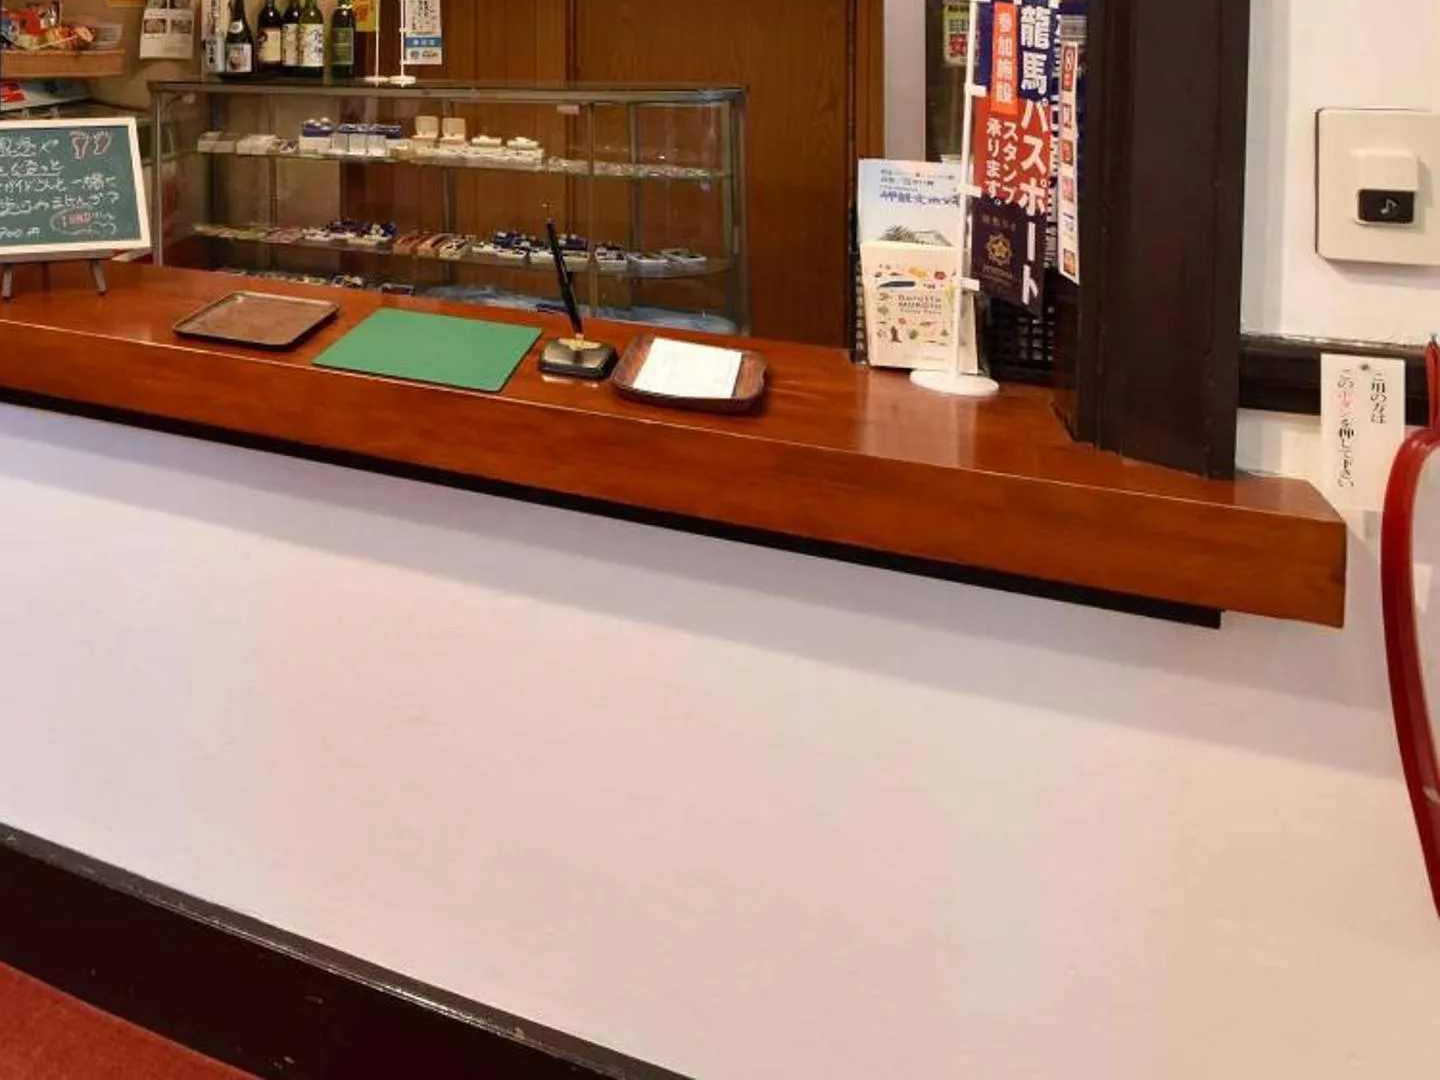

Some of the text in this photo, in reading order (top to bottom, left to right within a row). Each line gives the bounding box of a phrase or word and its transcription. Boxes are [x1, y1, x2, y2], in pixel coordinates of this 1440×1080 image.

[985, 118, 1003, 207] 承ります。
[1002, 122, 1019, 206] スタンプ
